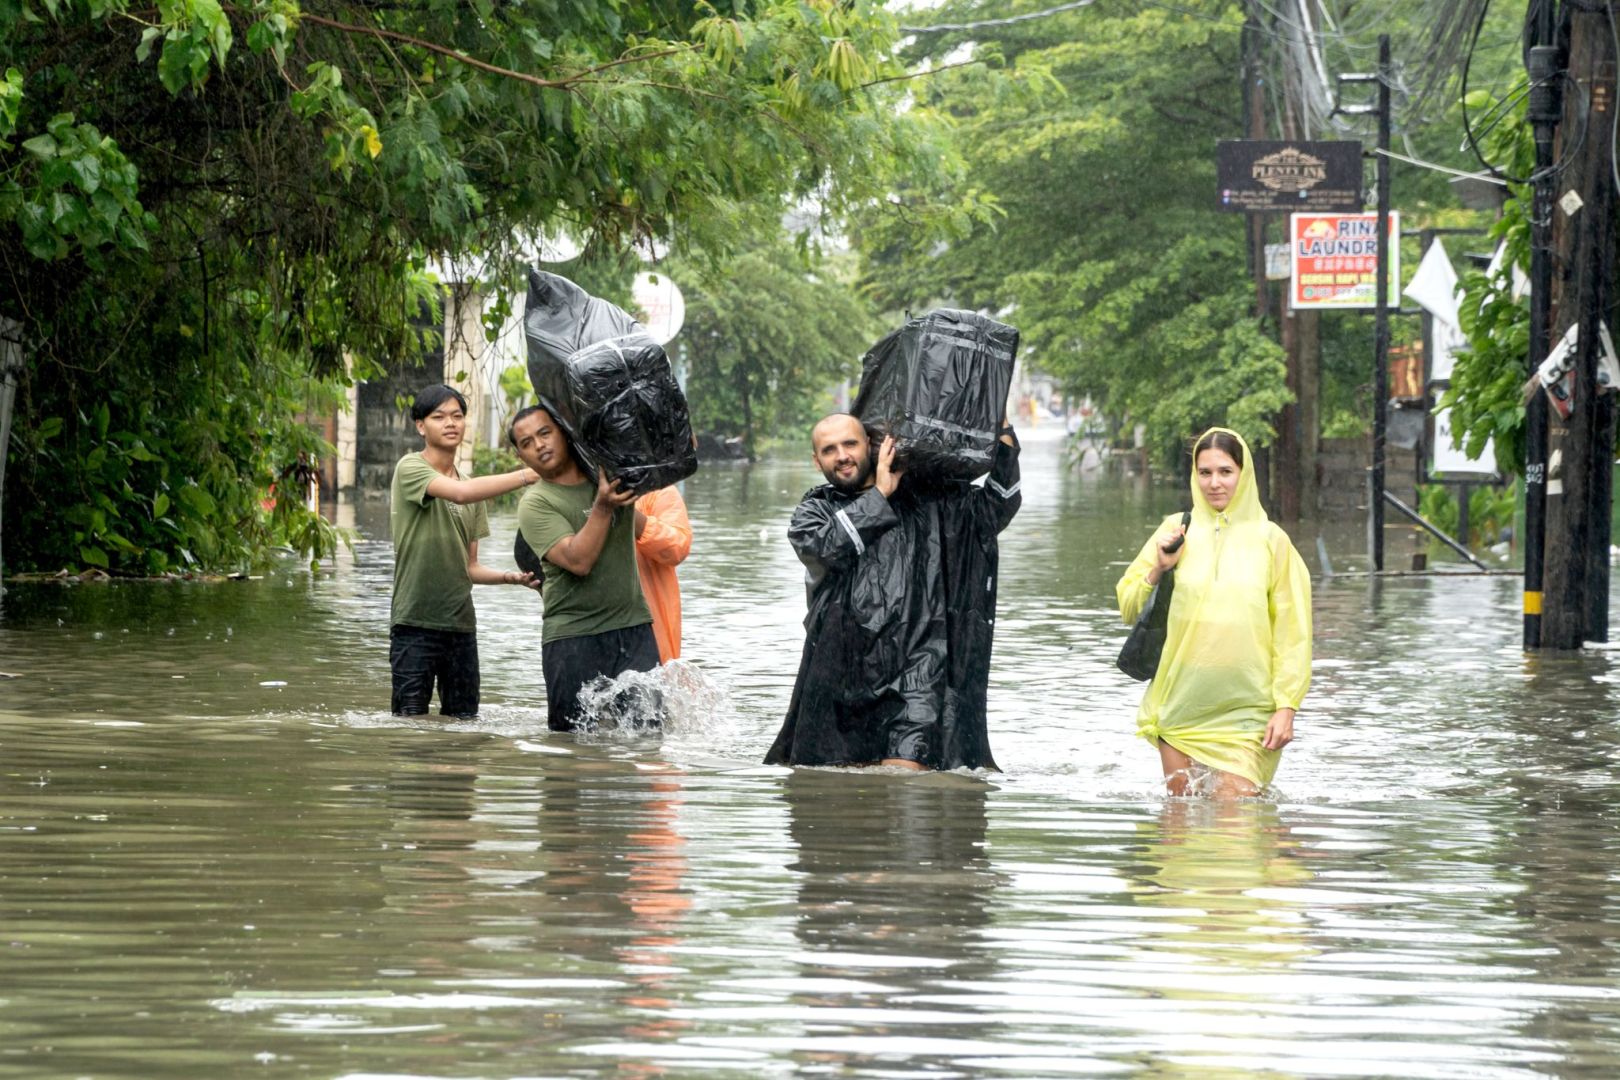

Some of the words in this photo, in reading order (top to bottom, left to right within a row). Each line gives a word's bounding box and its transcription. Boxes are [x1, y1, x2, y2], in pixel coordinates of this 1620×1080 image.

[1252, 165, 1298, 179] PLENTY
[1303, 165, 1327, 179] INK
[1299, 240, 1377, 255] LAUNDR
[1313, 258, 1377, 271] EXPRES
